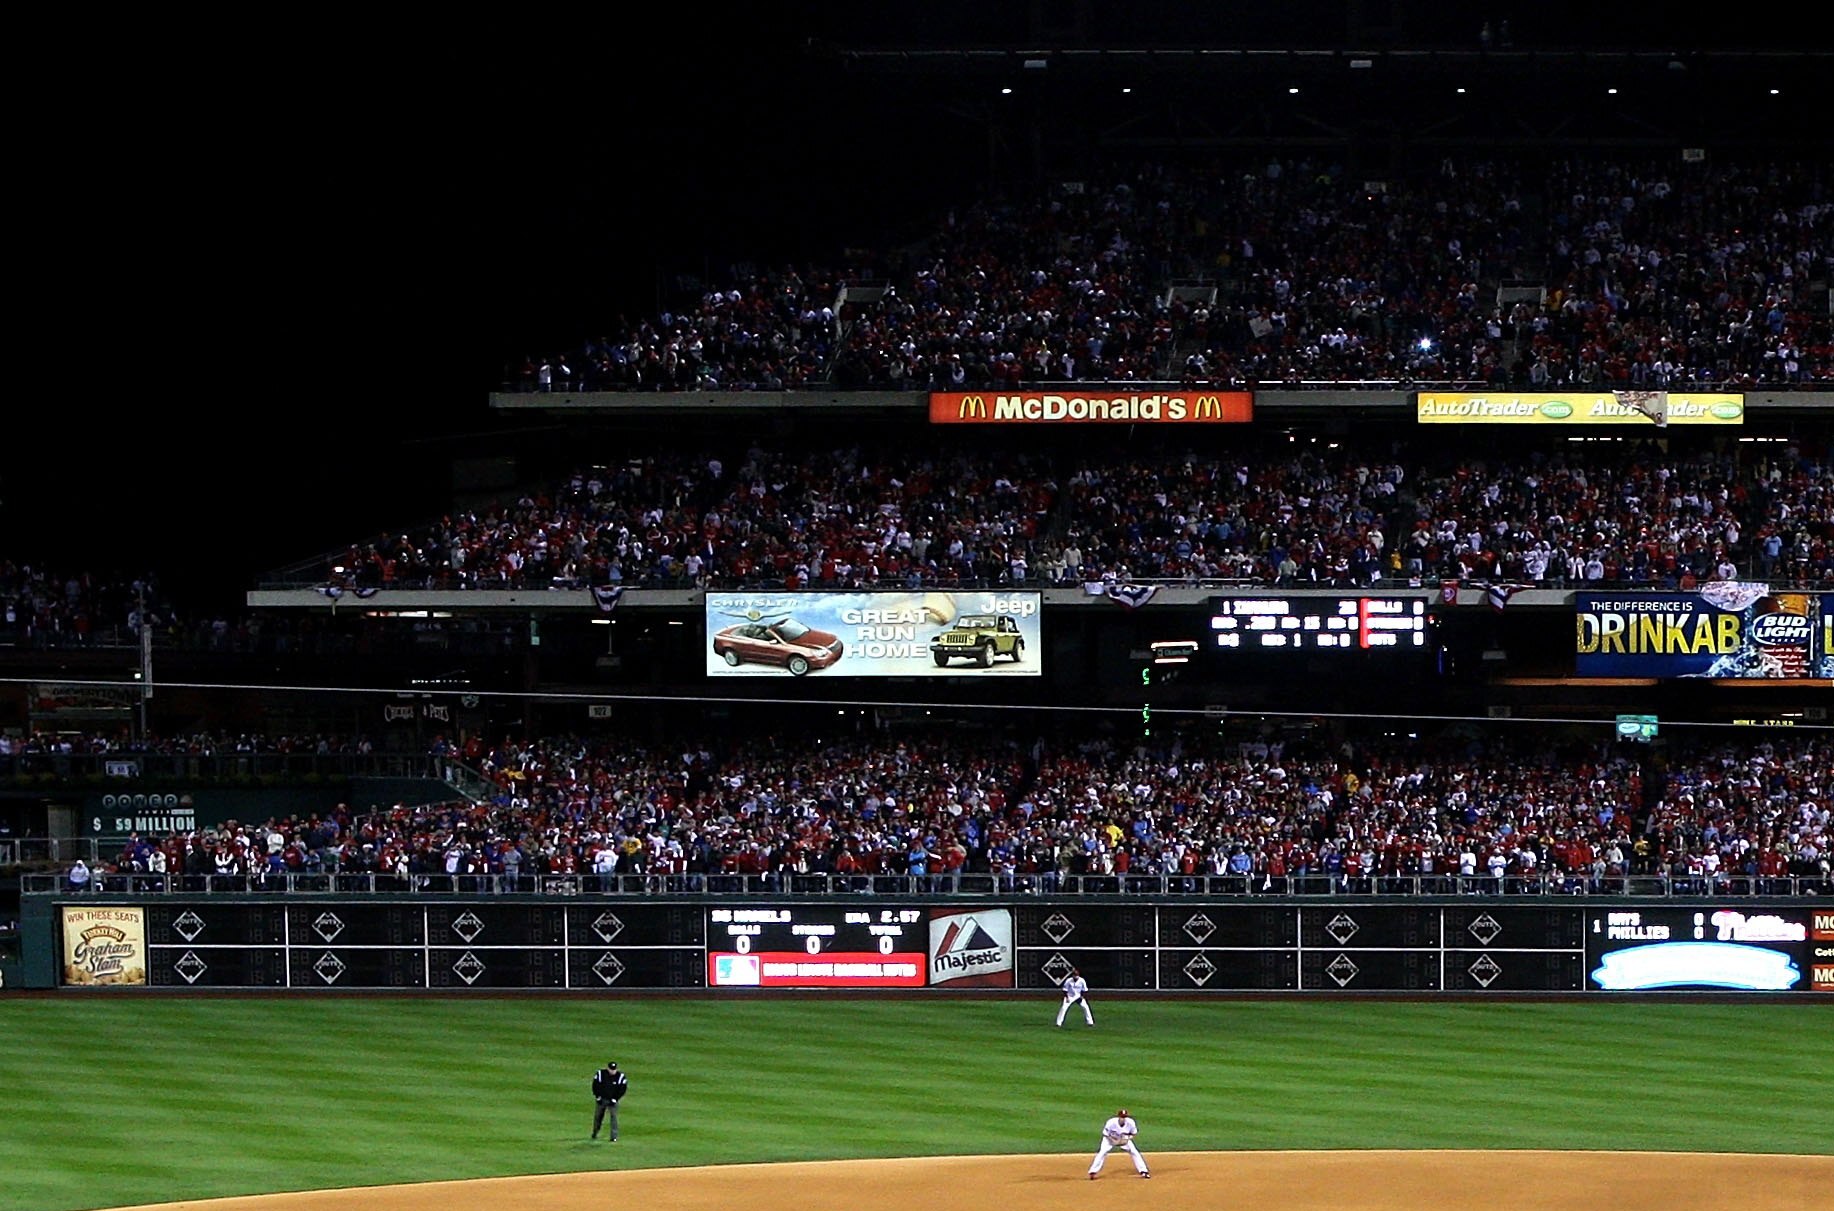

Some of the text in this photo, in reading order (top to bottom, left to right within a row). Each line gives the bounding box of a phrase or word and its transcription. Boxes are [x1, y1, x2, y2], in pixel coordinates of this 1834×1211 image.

[993, 395, 1187, 420] McDonald's
[711, 599, 798, 608] CHRYSLER
[980, 596, 1036, 617] Jeep
[1591, 601, 1693, 612] THE DIFFERENCE IS
[841, 609, 930, 624] GREAT
[1763, 616, 1807, 627] BUD
[857, 626, 915, 641] RUN
[1756, 627, 1810, 638] LIGHT
[847, 643, 928, 658] HOME
[93, 816, 195, 832] $ 59 MILLION
[67, 911, 140, 924] WIN THESE SEATS
[1607, 926, 1670, 939] PHILLIES
[736, 935, 751, 954] 0
[806, 935, 821, 954] 0
[879, 935, 894, 954] 0
[73, 942, 136, 965] Graham
[86, 956, 124, 979] Slam
[934, 950, 1002, 973] Majestic
